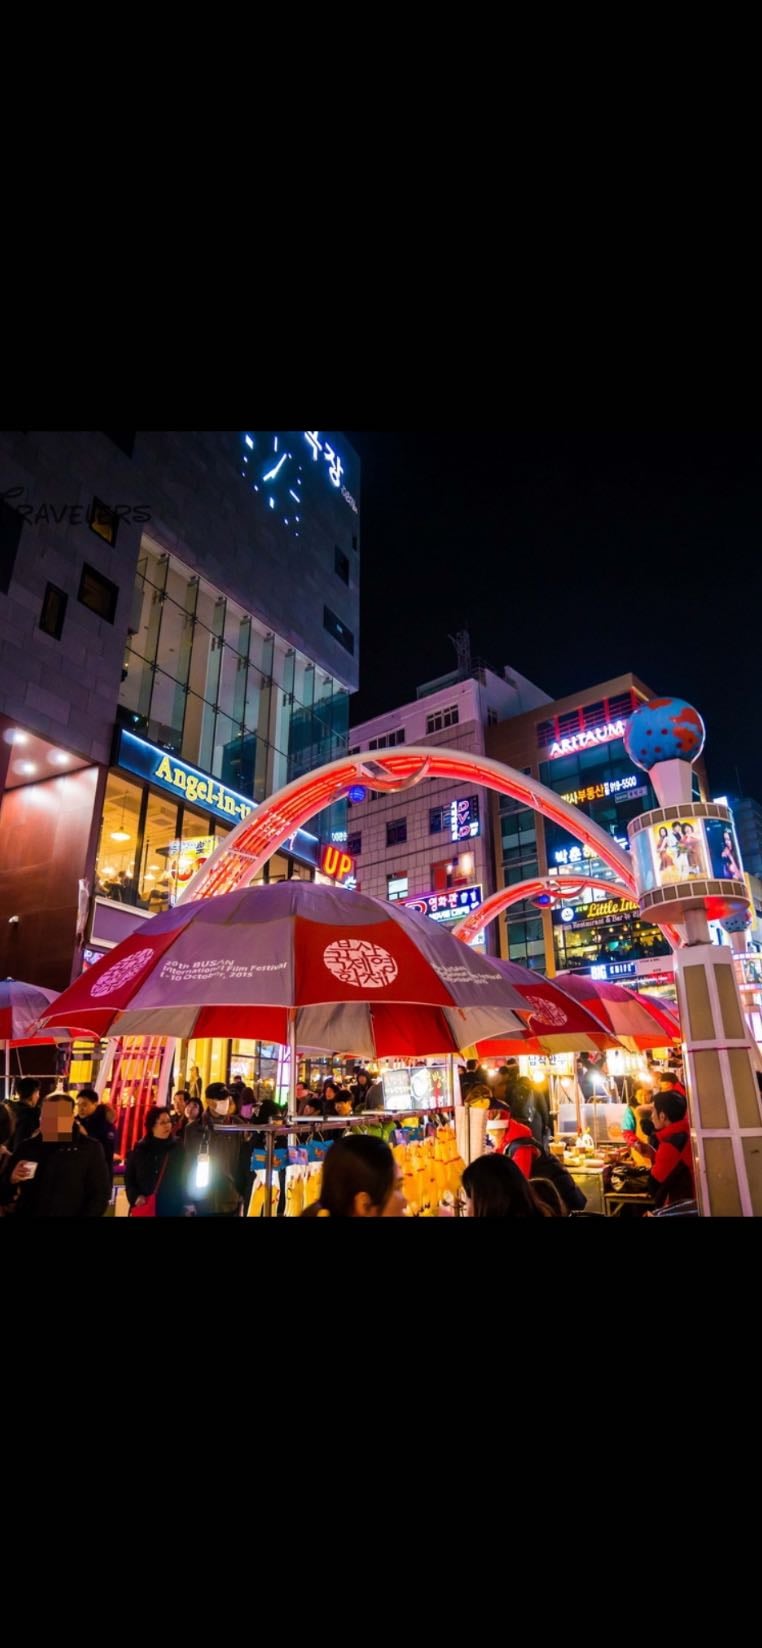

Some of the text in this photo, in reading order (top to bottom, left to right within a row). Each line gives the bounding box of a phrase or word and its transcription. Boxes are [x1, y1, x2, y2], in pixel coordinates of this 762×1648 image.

[549, 720, 625, 757] ARITAUM
[323, 846, 352, 881] UP
[587, 900, 619, 918] Little
[163, 961, 288, 975] International Film Festival
[166, 959, 235, 970] 20th BUSAN
